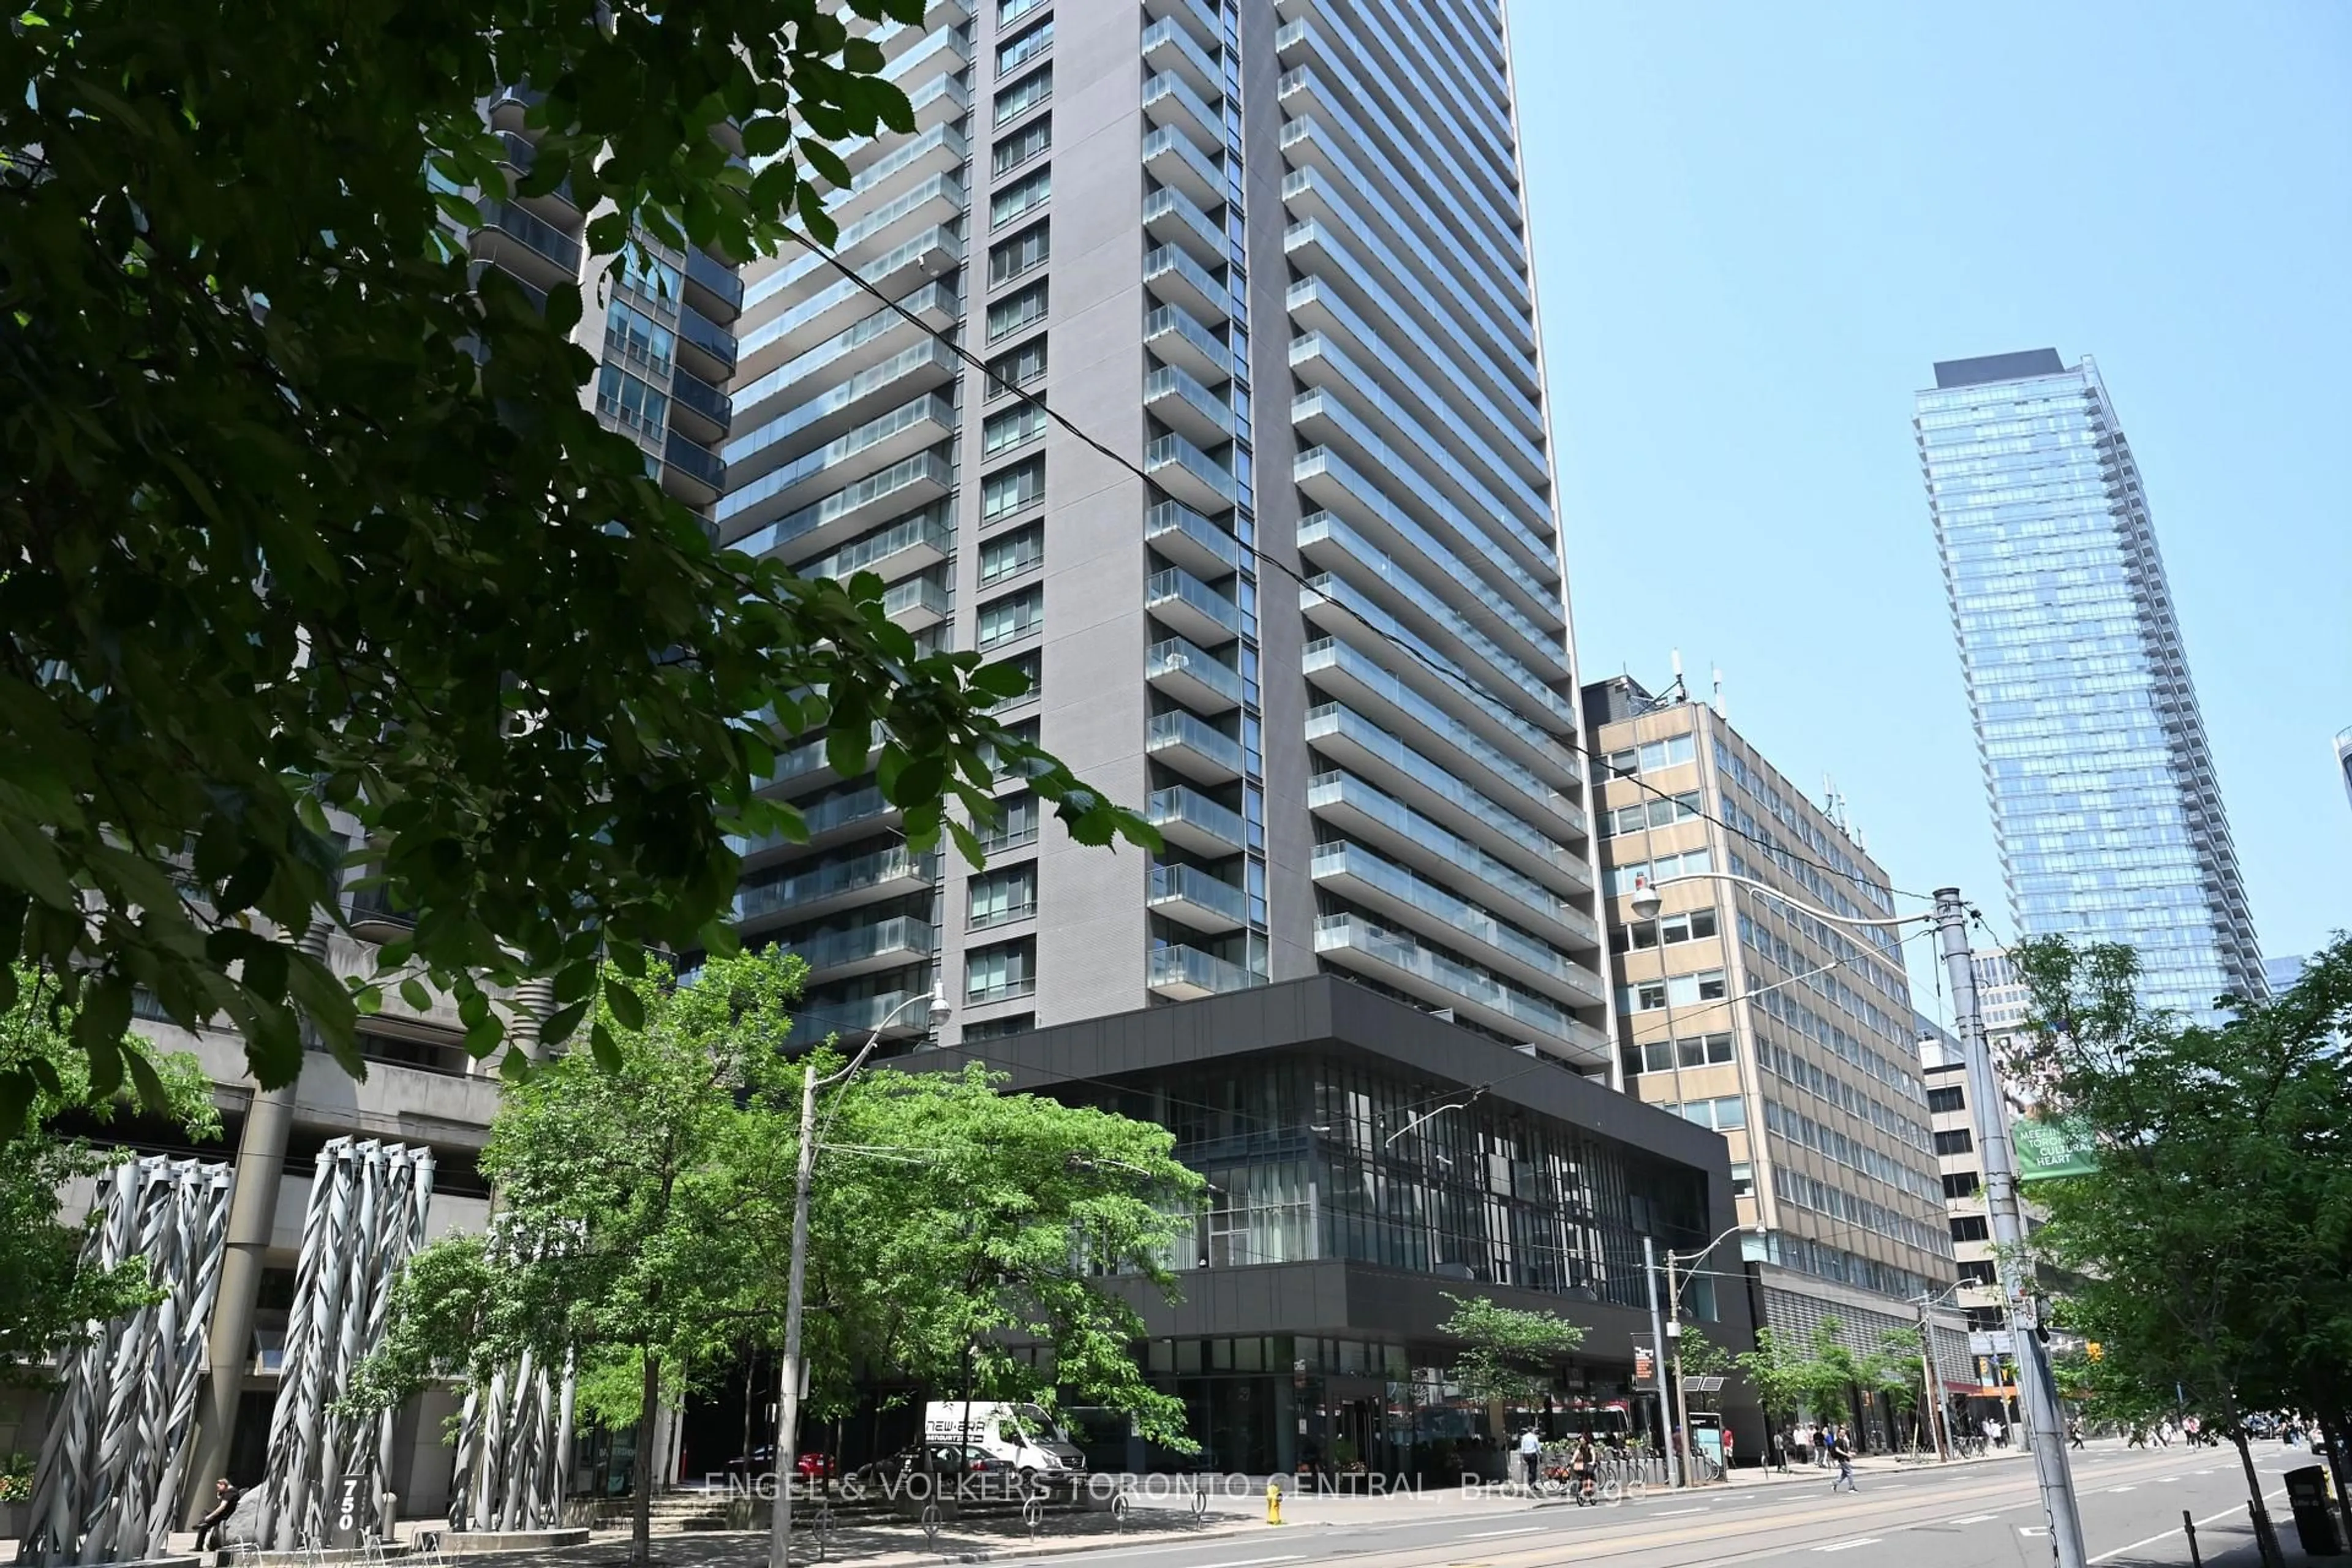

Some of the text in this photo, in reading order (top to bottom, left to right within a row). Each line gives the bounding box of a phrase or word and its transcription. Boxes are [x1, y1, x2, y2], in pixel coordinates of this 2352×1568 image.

[2021, 1127, 2060, 1140] MEET IN
[2040, 1144, 2094, 1156] CULTURAL
[2036, 1154, 2071, 1166] HEART
[339, 1480, 357, 1530] 750
